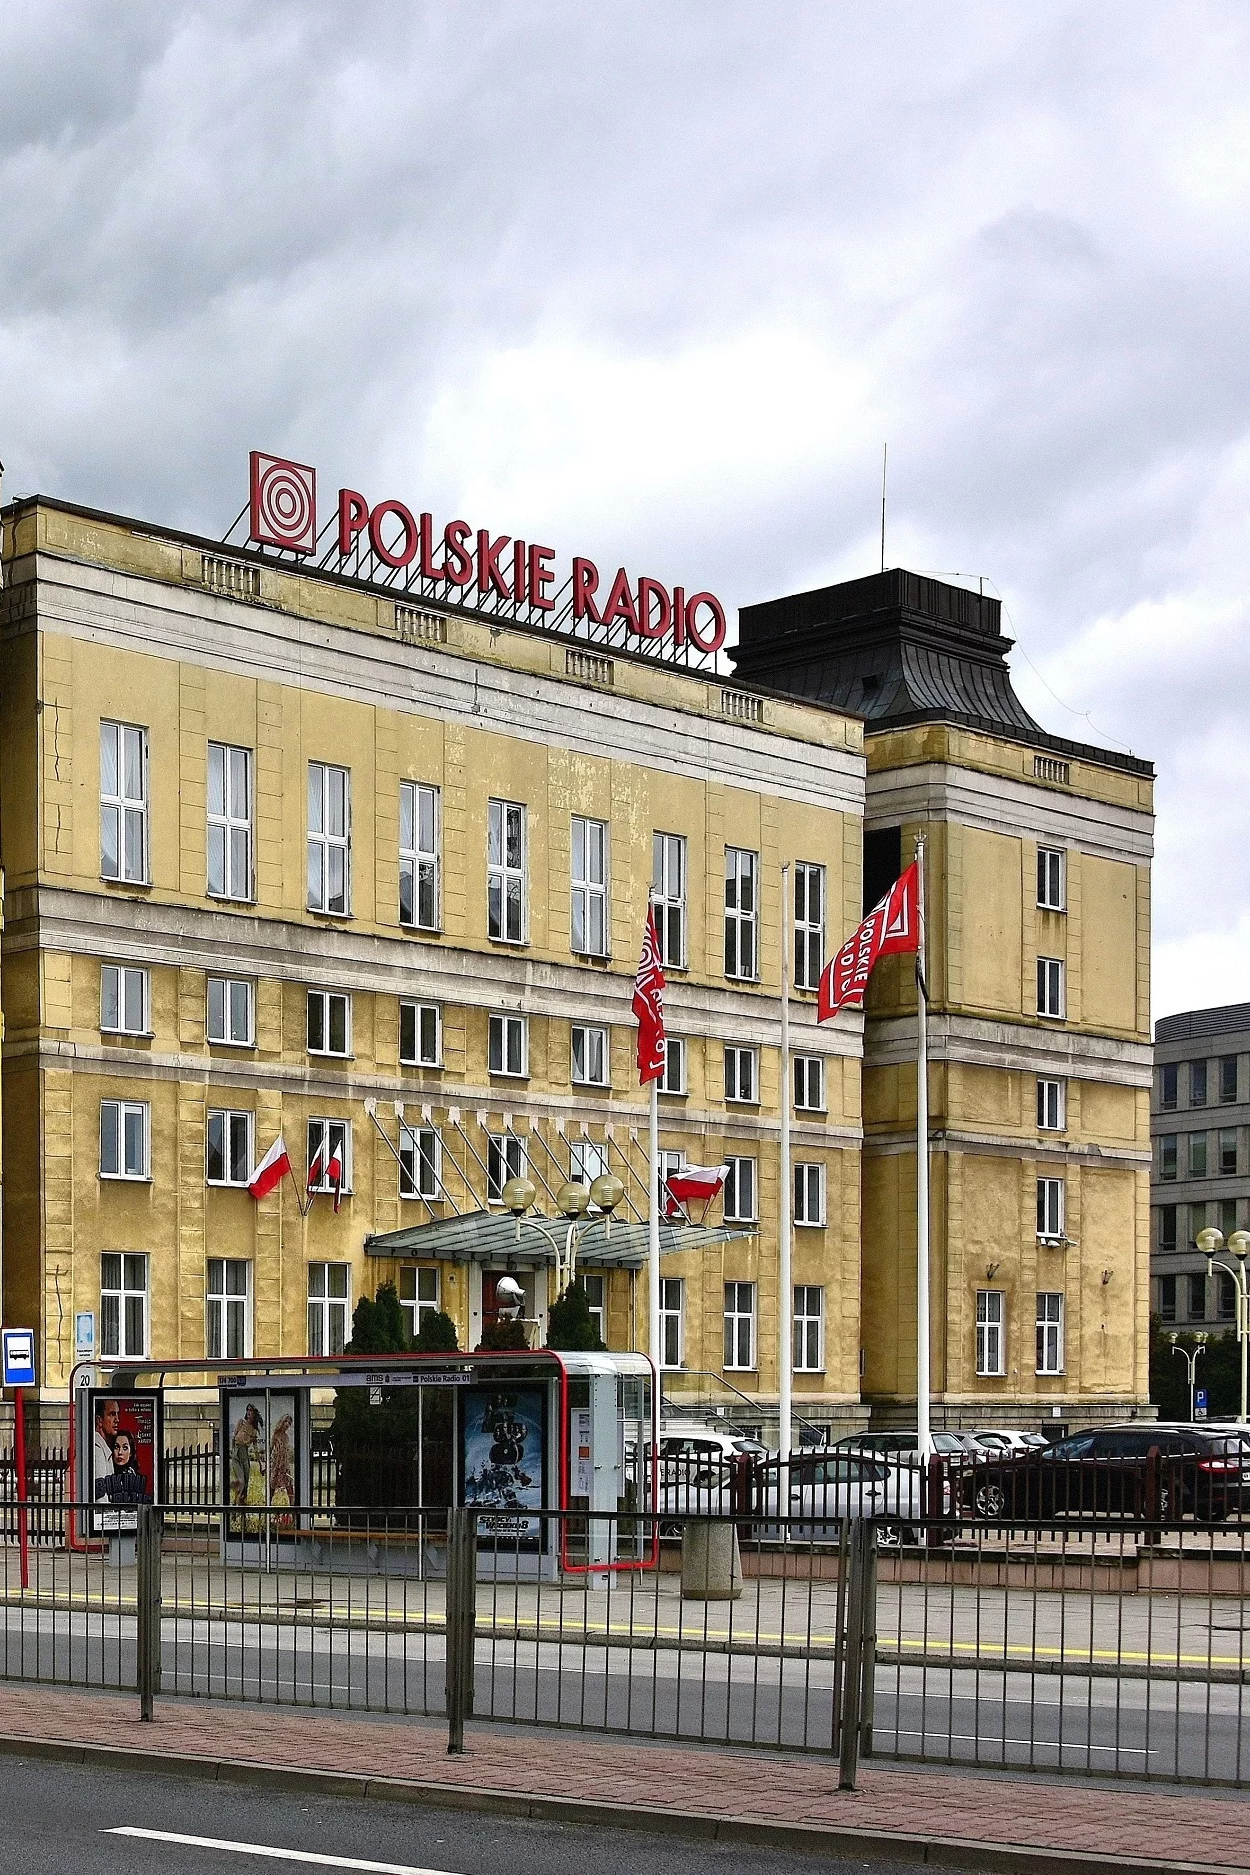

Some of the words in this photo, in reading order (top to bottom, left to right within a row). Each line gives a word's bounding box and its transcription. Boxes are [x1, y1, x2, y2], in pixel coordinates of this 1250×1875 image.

[339, 488, 555, 611] POLSKIE
[572, 557, 726, 653] RADIO
[854, 918, 876, 982] POLSKIE
[545, 1255, 624, 1268] RDIO
[80, 1374, 90, 1387] 20
[420, 1375, 442, 1383] Polskie
[443, 1375, 461, 1383] Radio
[462, 1374, 470, 1382] 01
